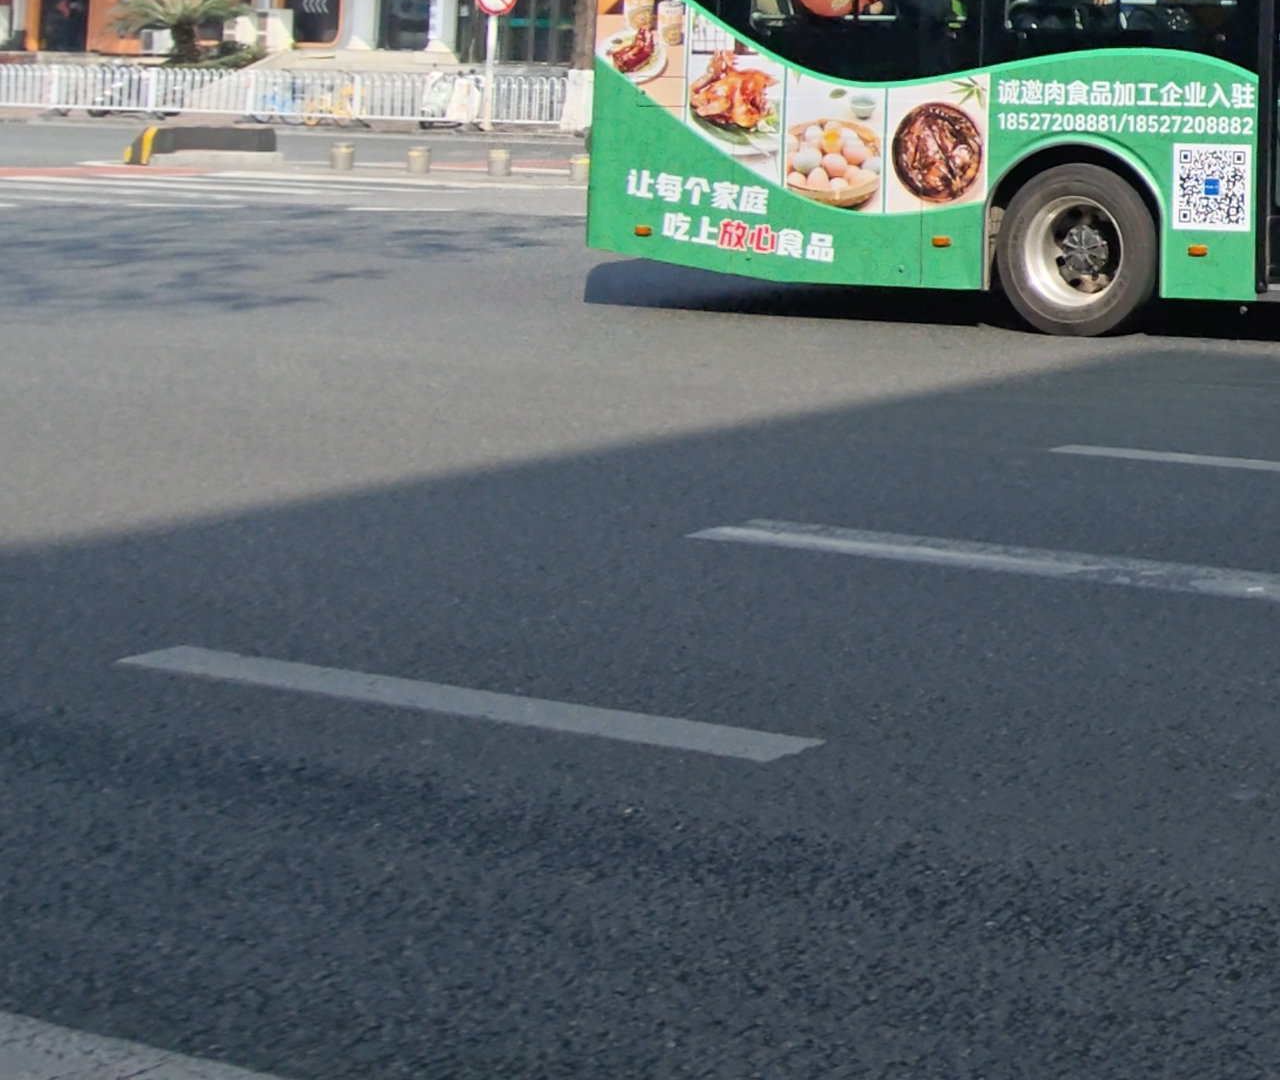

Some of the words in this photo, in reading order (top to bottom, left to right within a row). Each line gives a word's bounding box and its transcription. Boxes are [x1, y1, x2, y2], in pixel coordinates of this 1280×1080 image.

[997, 80, 1255, 108] 诚邀肉食品加工企业入驻
[997, 113, 1254, 135] 18527208881/18527208882
[626, 168, 769, 215] 让每个家庭
[661, 211, 835, 263] 吃上放心食品
